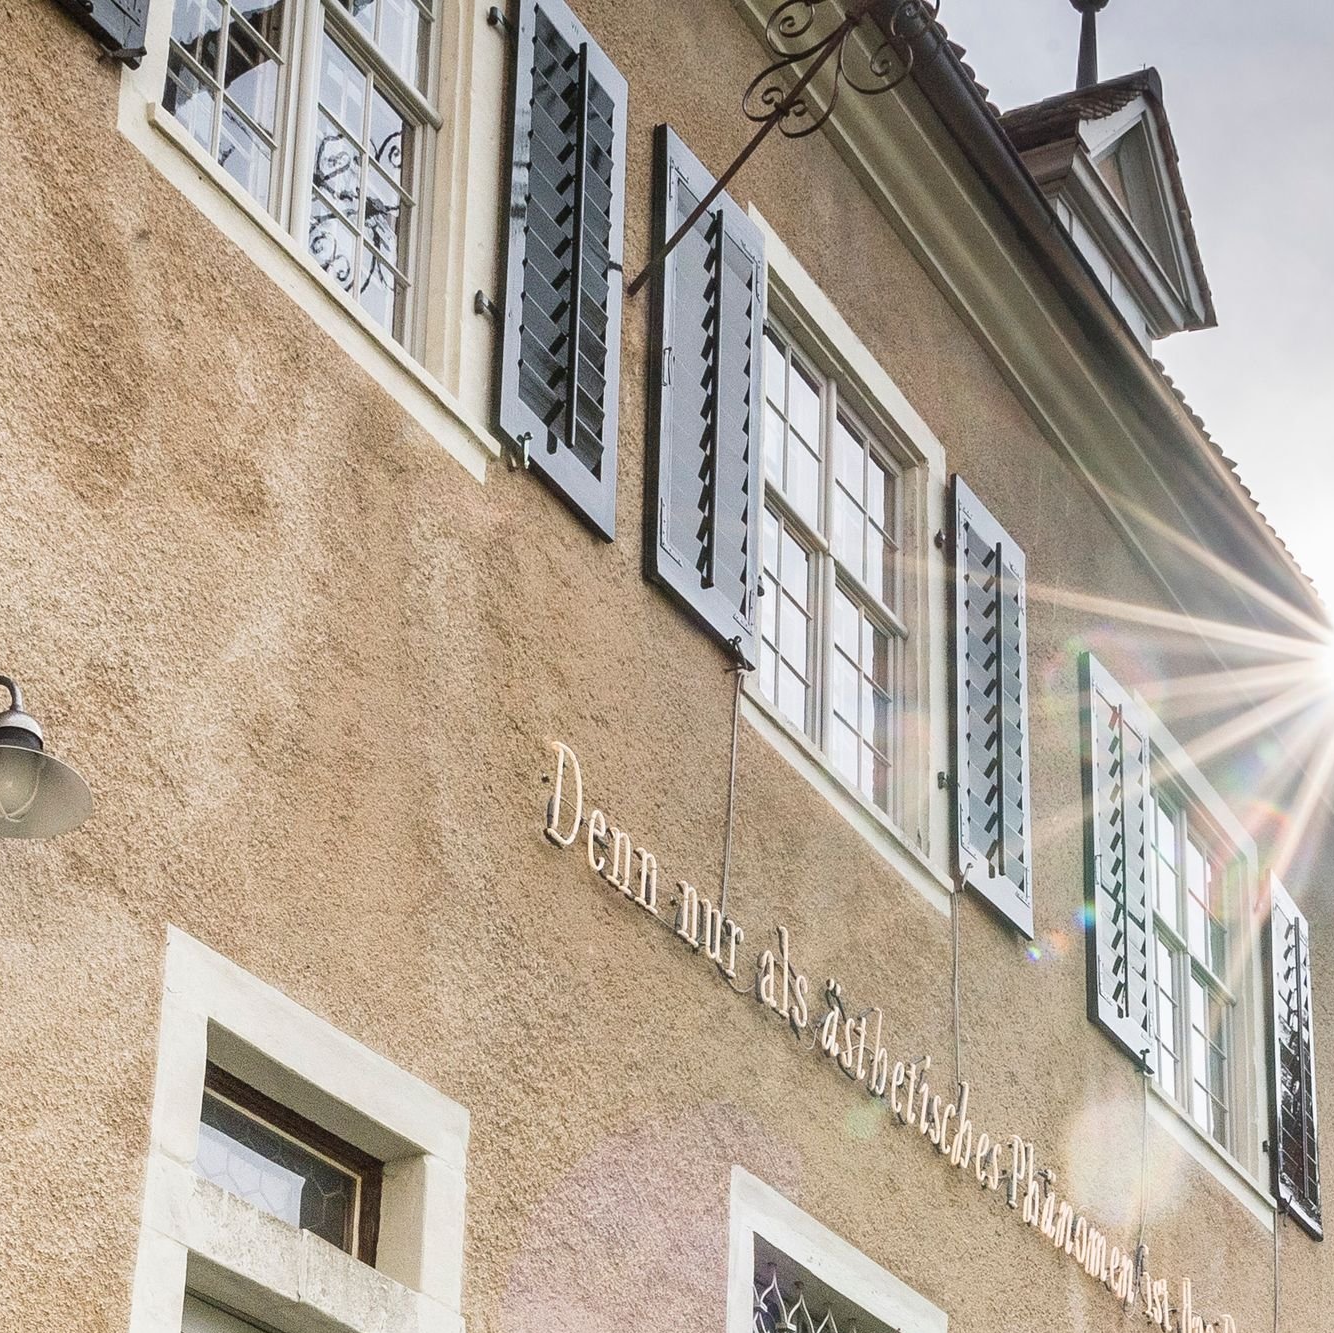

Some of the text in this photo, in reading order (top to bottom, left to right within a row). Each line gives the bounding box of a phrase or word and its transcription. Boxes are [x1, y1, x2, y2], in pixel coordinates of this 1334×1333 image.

[547, 741, 657, 914] Denn
[677, 881, 743, 977] nur
[761, 926, 807, 1028] als
[1142, 1245, 1171, 1331] ist
